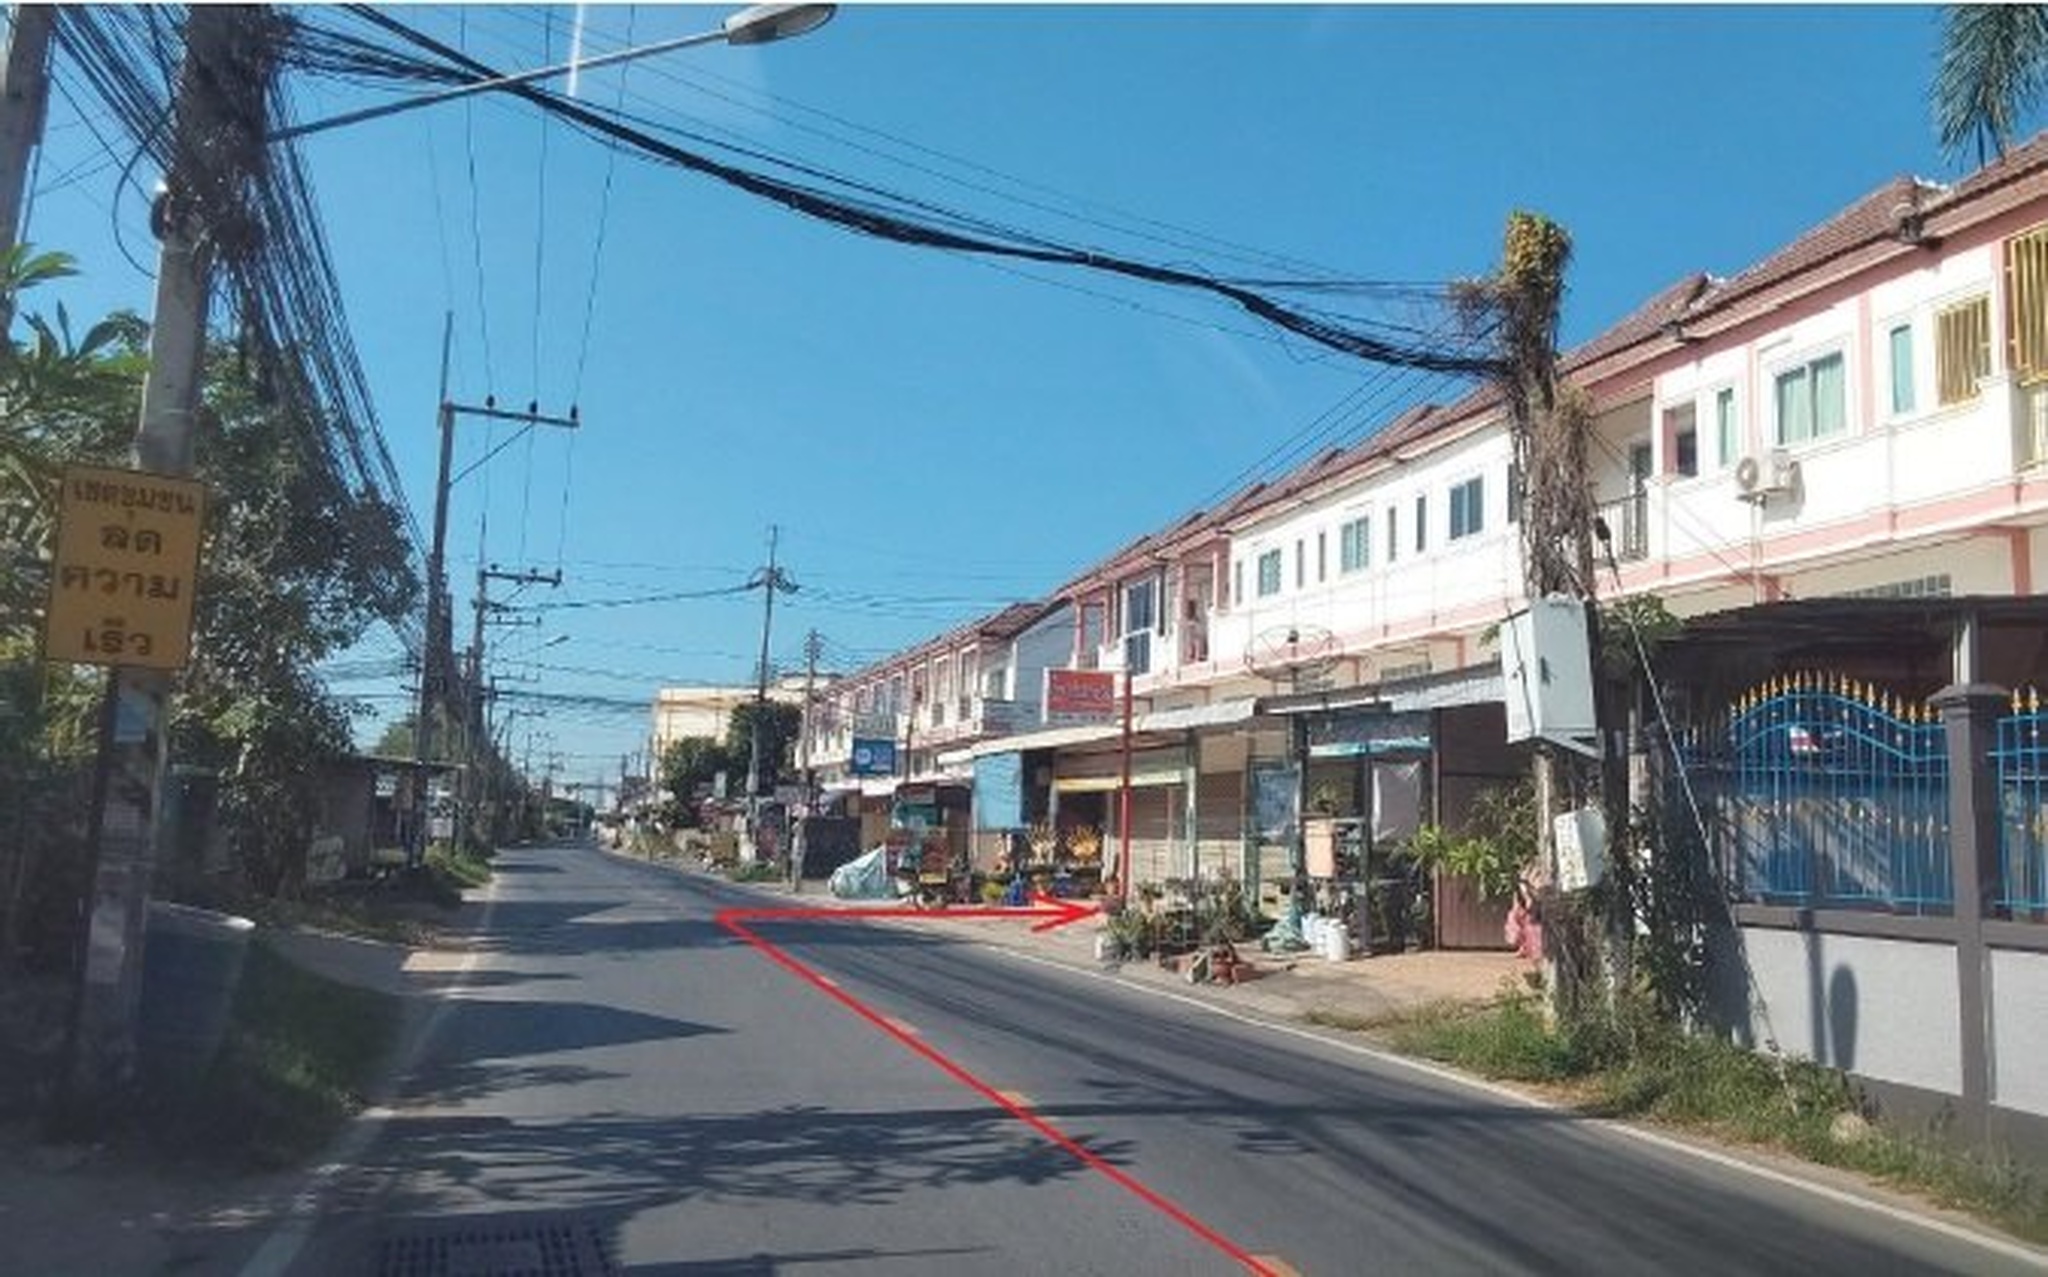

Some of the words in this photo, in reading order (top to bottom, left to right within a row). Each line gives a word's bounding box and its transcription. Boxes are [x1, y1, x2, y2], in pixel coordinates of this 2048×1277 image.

[101, 525, 162, 555] ลด
[61, 566, 180, 600] ความ
[83, 617, 153, 655] เร็ว
